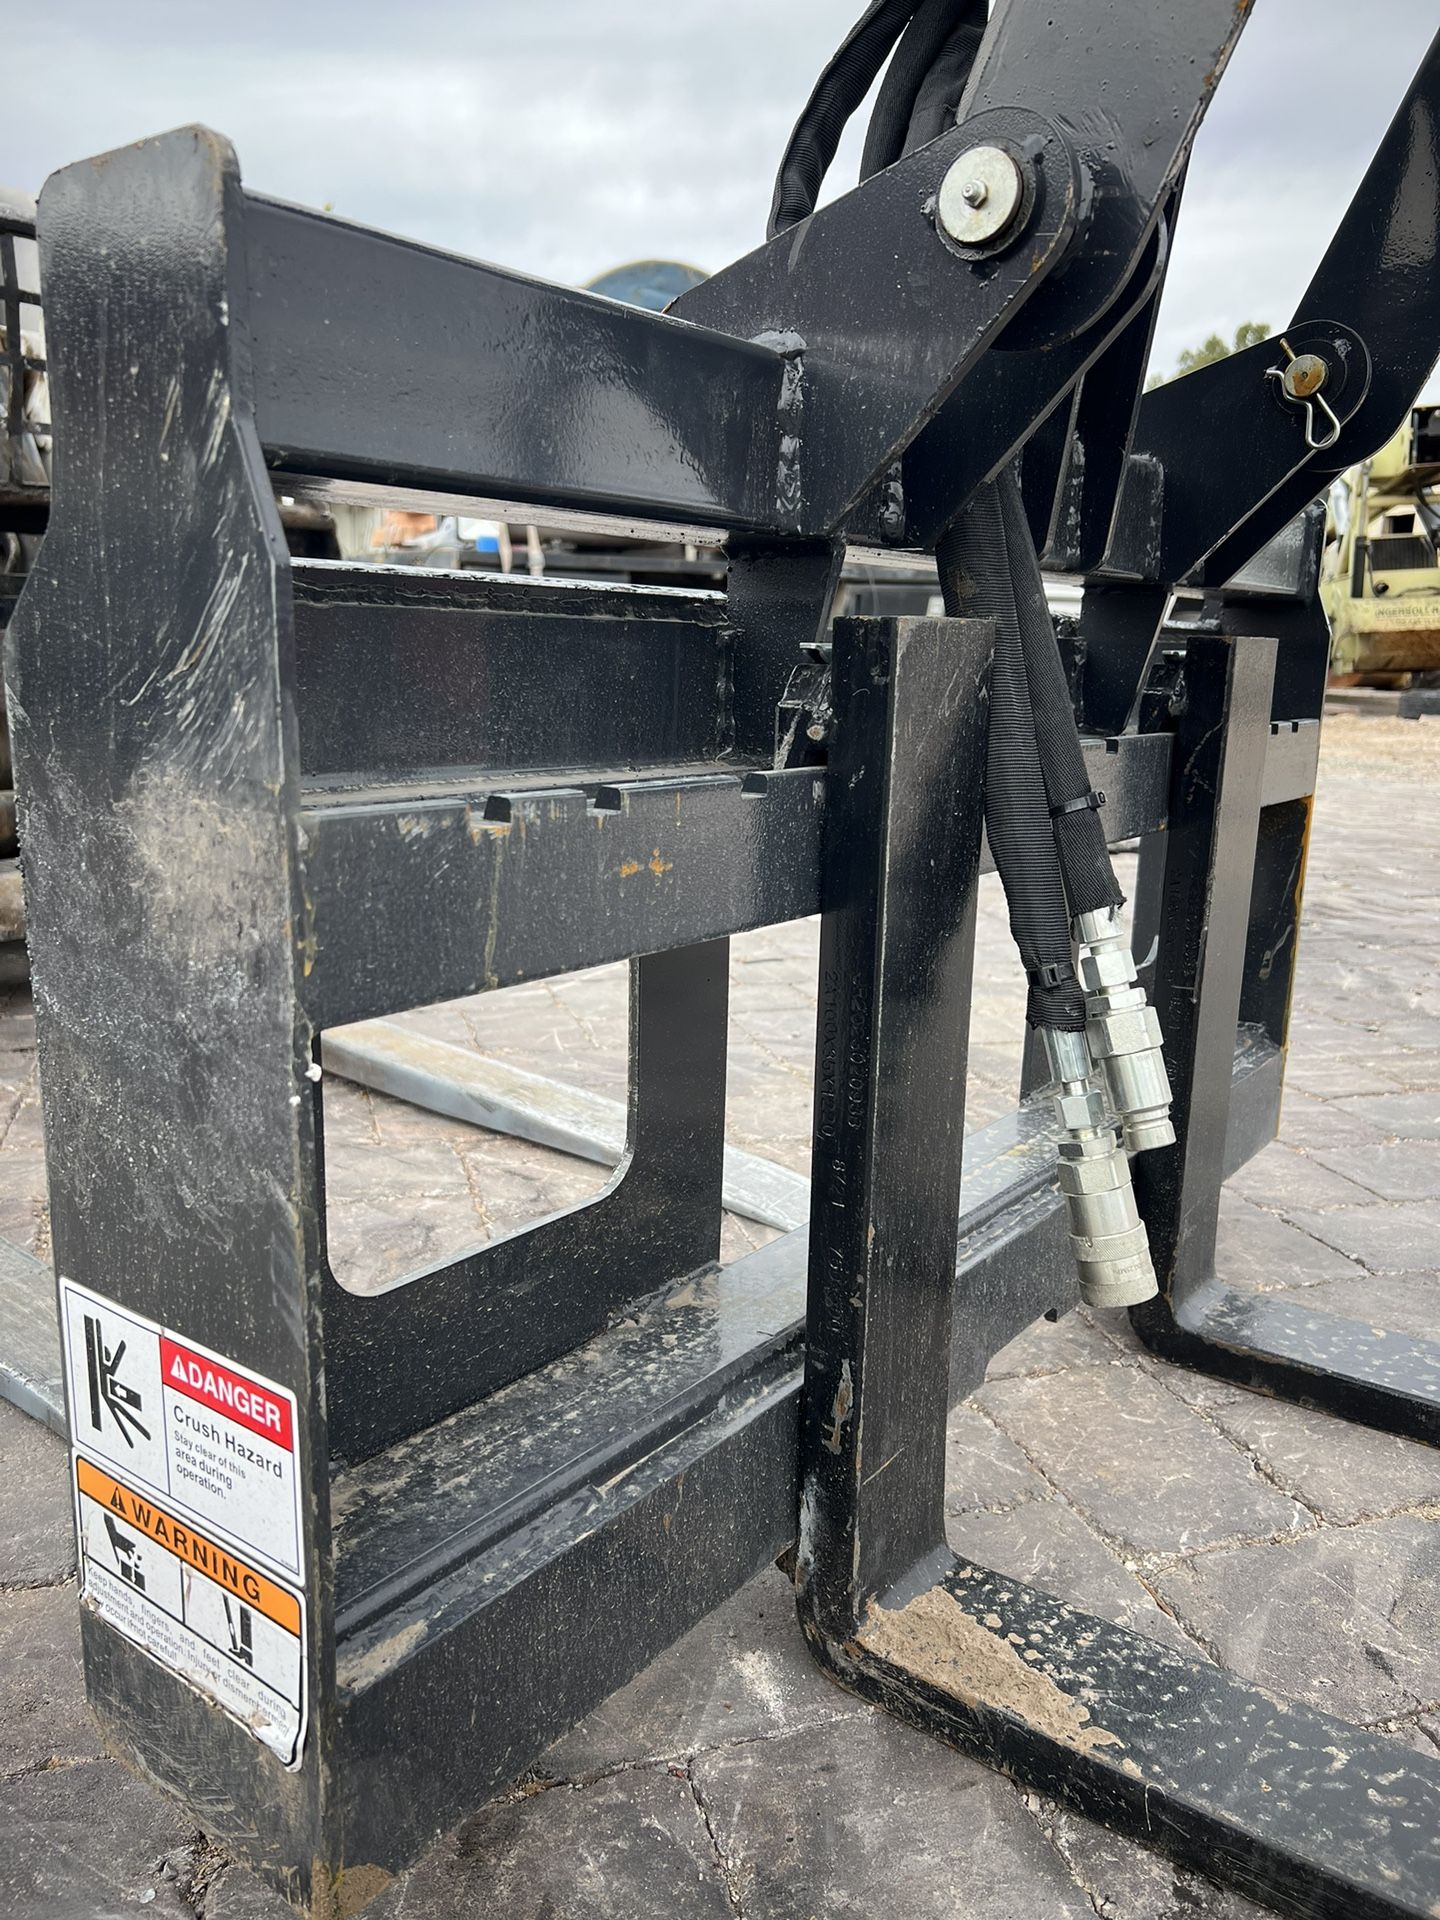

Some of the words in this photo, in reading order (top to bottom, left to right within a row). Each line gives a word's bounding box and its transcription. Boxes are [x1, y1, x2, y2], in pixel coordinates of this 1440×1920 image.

[187, 1362, 281, 1432] DANGER
[173, 1406, 219, 1443] Crush
[225, 1432, 282, 1478] Hazard
[174, 1430, 192, 1450] Stay
[195, 1444, 216, 1462] clear
[218, 1457, 227, 1467] of
[229, 1461, 245, 1478] this
[175, 1448, 196, 1466] area
[199, 1460, 232, 1489] during
[176, 1463, 226, 1499] operation.
[132, 1498, 261, 1603] WARNING
[88, 1579, 129, 1614] adjustment
[130, 1609, 144, 1625] and
[105, 1604, 126, 1624] occur
[88, 1567, 107, 1589] Keep
[108, 1581, 134, 1608] hands,
[141, 1605, 172, 1634] fingers,
[179, 1633, 195, 1651] and
[203, 1649, 219, 1669] feet
[227, 1669, 249, 1690] clear
[258, 1691, 286, 1718] during
